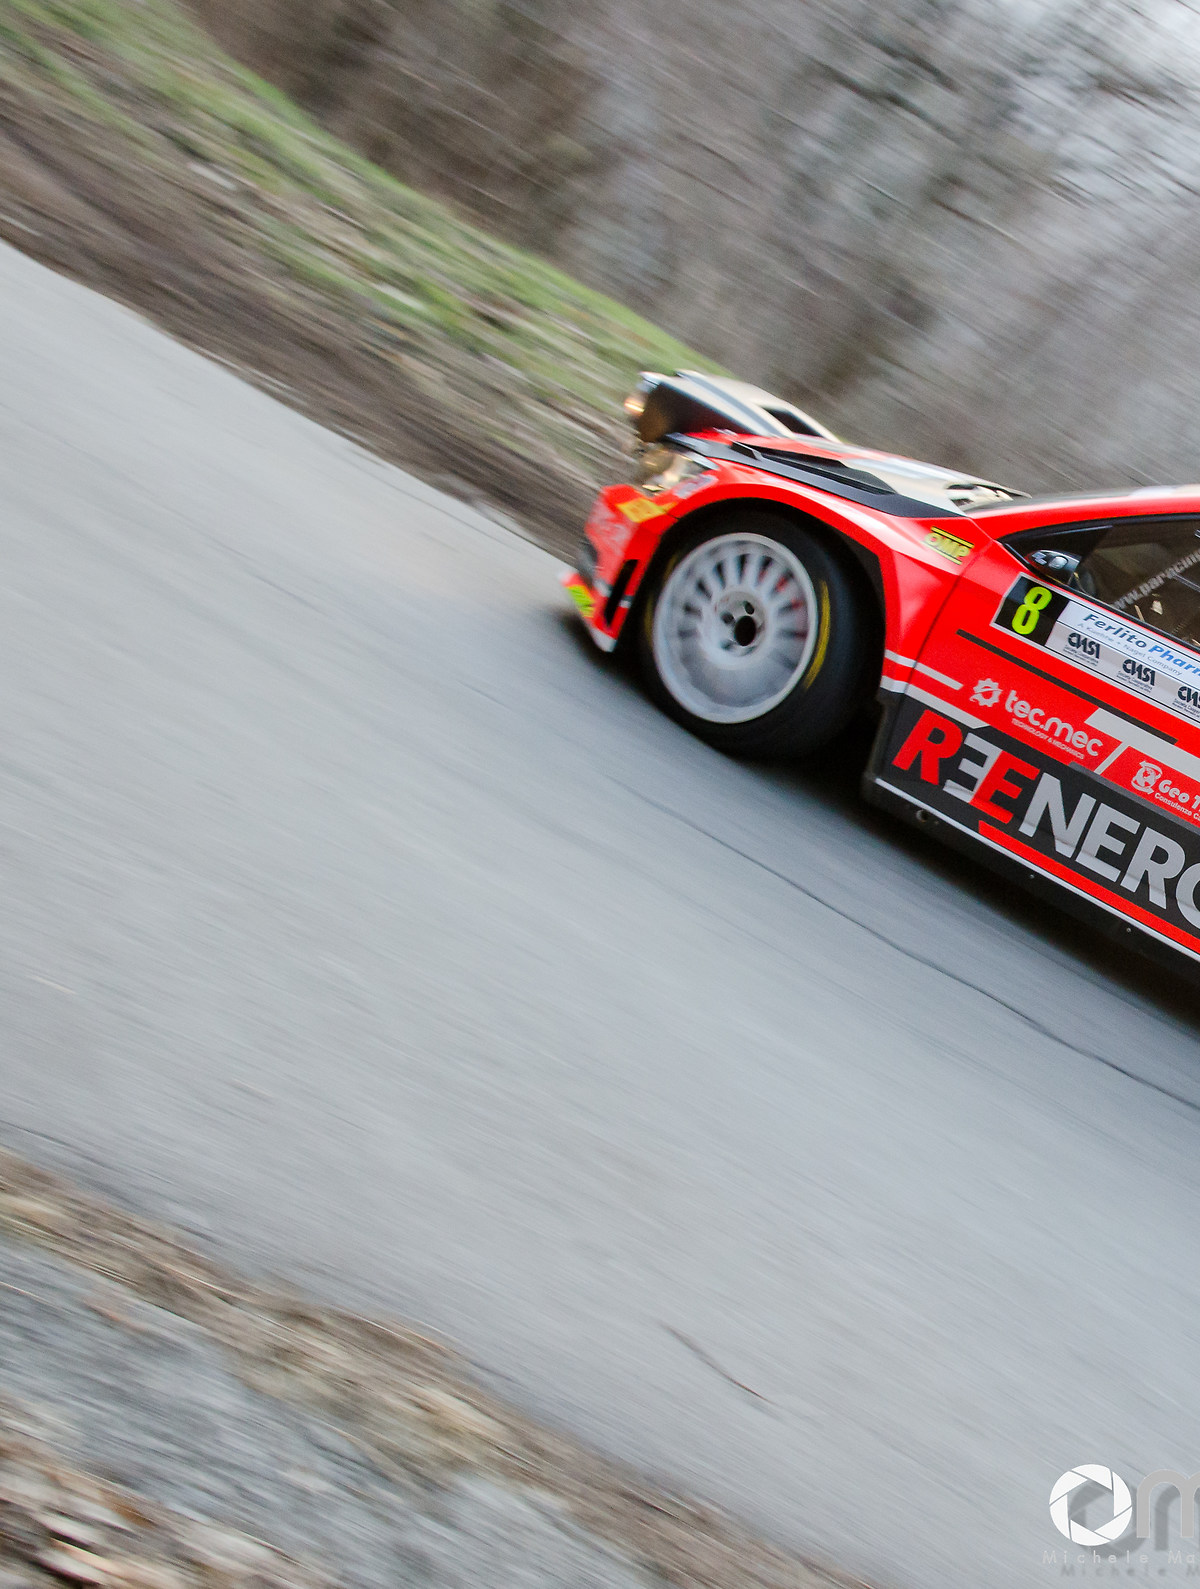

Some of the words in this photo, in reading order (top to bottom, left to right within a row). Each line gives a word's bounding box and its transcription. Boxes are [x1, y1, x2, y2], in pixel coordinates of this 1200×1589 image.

[1011, 586, 1052, 635] 8
[1083, 613, 1147, 648] Ferlito
[1004, 689, 1104, 757] tec.mec
[1012, 718, 1050, 743] TECHNOLOGY
[1157, 777, 1191, 804] Geo
